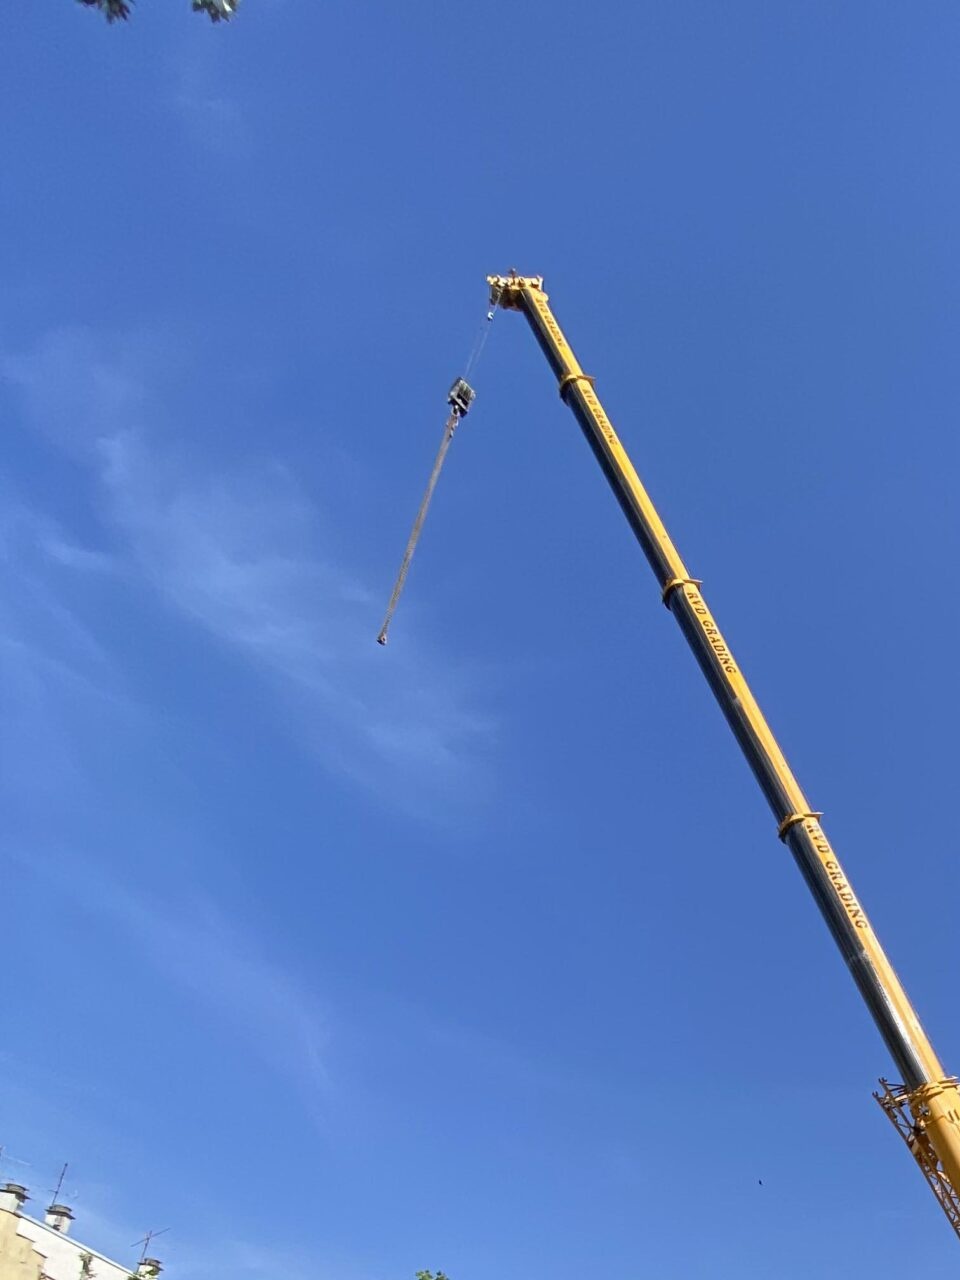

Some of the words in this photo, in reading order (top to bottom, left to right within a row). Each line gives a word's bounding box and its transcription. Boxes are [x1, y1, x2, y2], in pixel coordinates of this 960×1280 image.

[687, 592, 706, 615] RVD
[703, 620, 737, 673] GRADING
[806, 824, 830, 853] RVD
[825, 860, 868, 929] GRADING
